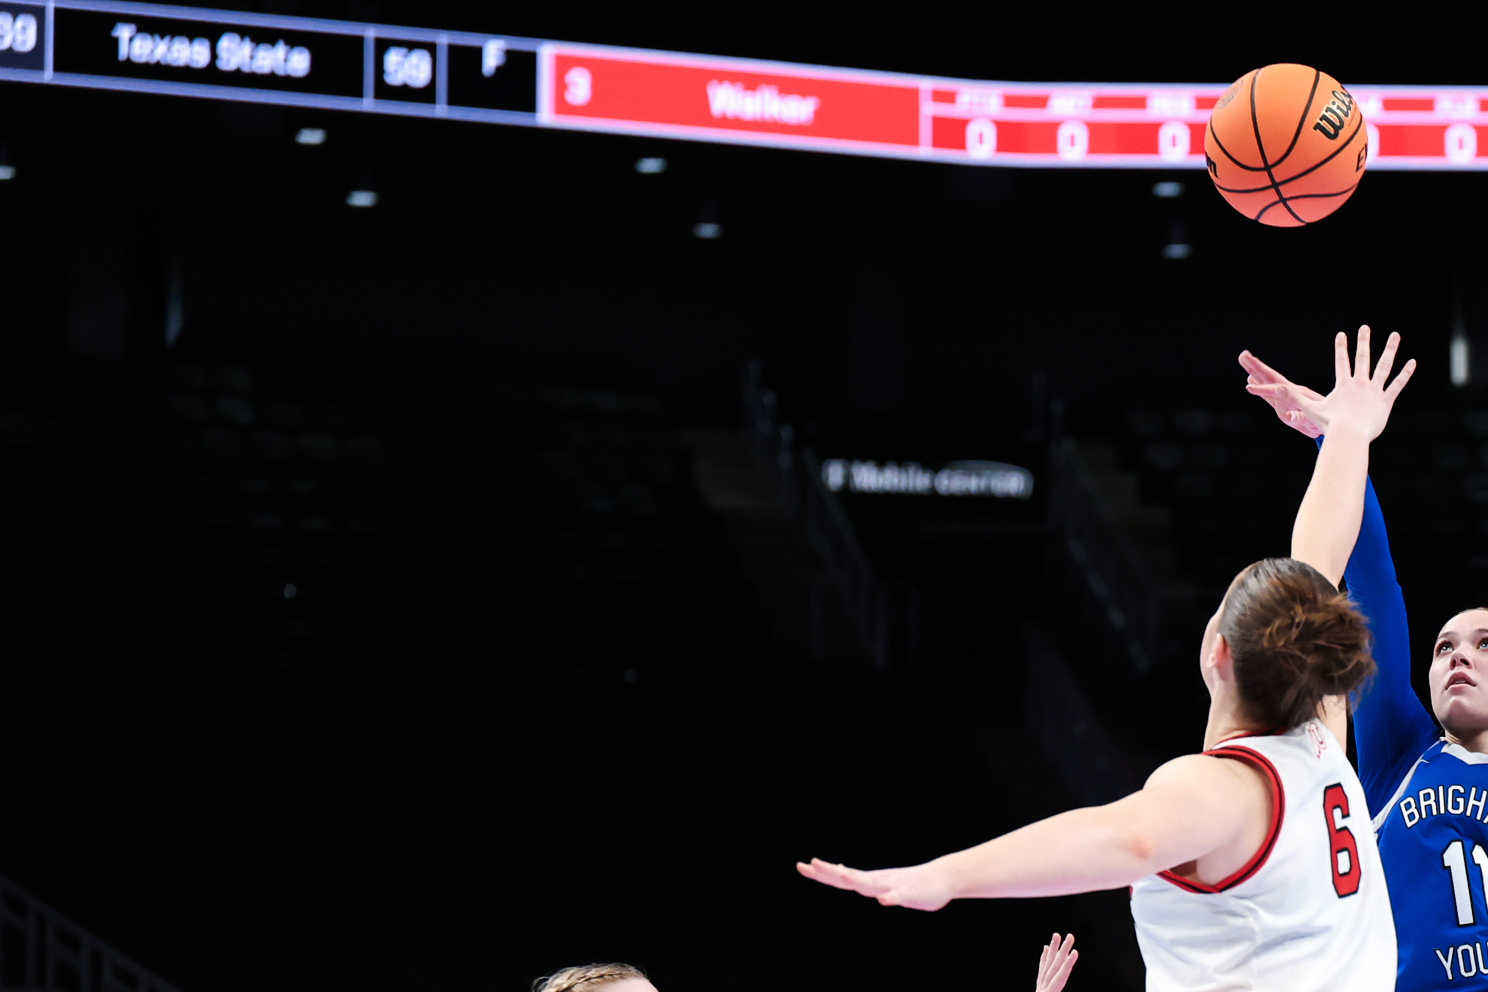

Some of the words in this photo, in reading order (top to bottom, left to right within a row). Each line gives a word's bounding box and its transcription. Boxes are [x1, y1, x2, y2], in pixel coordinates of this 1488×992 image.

[112, 23, 210, 68] Texas
[216, 32, 311, 77] State
[564, 66, 592, 107] 3
[707, 80, 820, 126] Walker
[966, 117, 997, 160] 0
[1057, 119, 1089, 161] 0
[1158, 120, 1190, 162] 0
[1444, 122, 1477, 164] 0
[1323, 782, 1362, 898] 6
